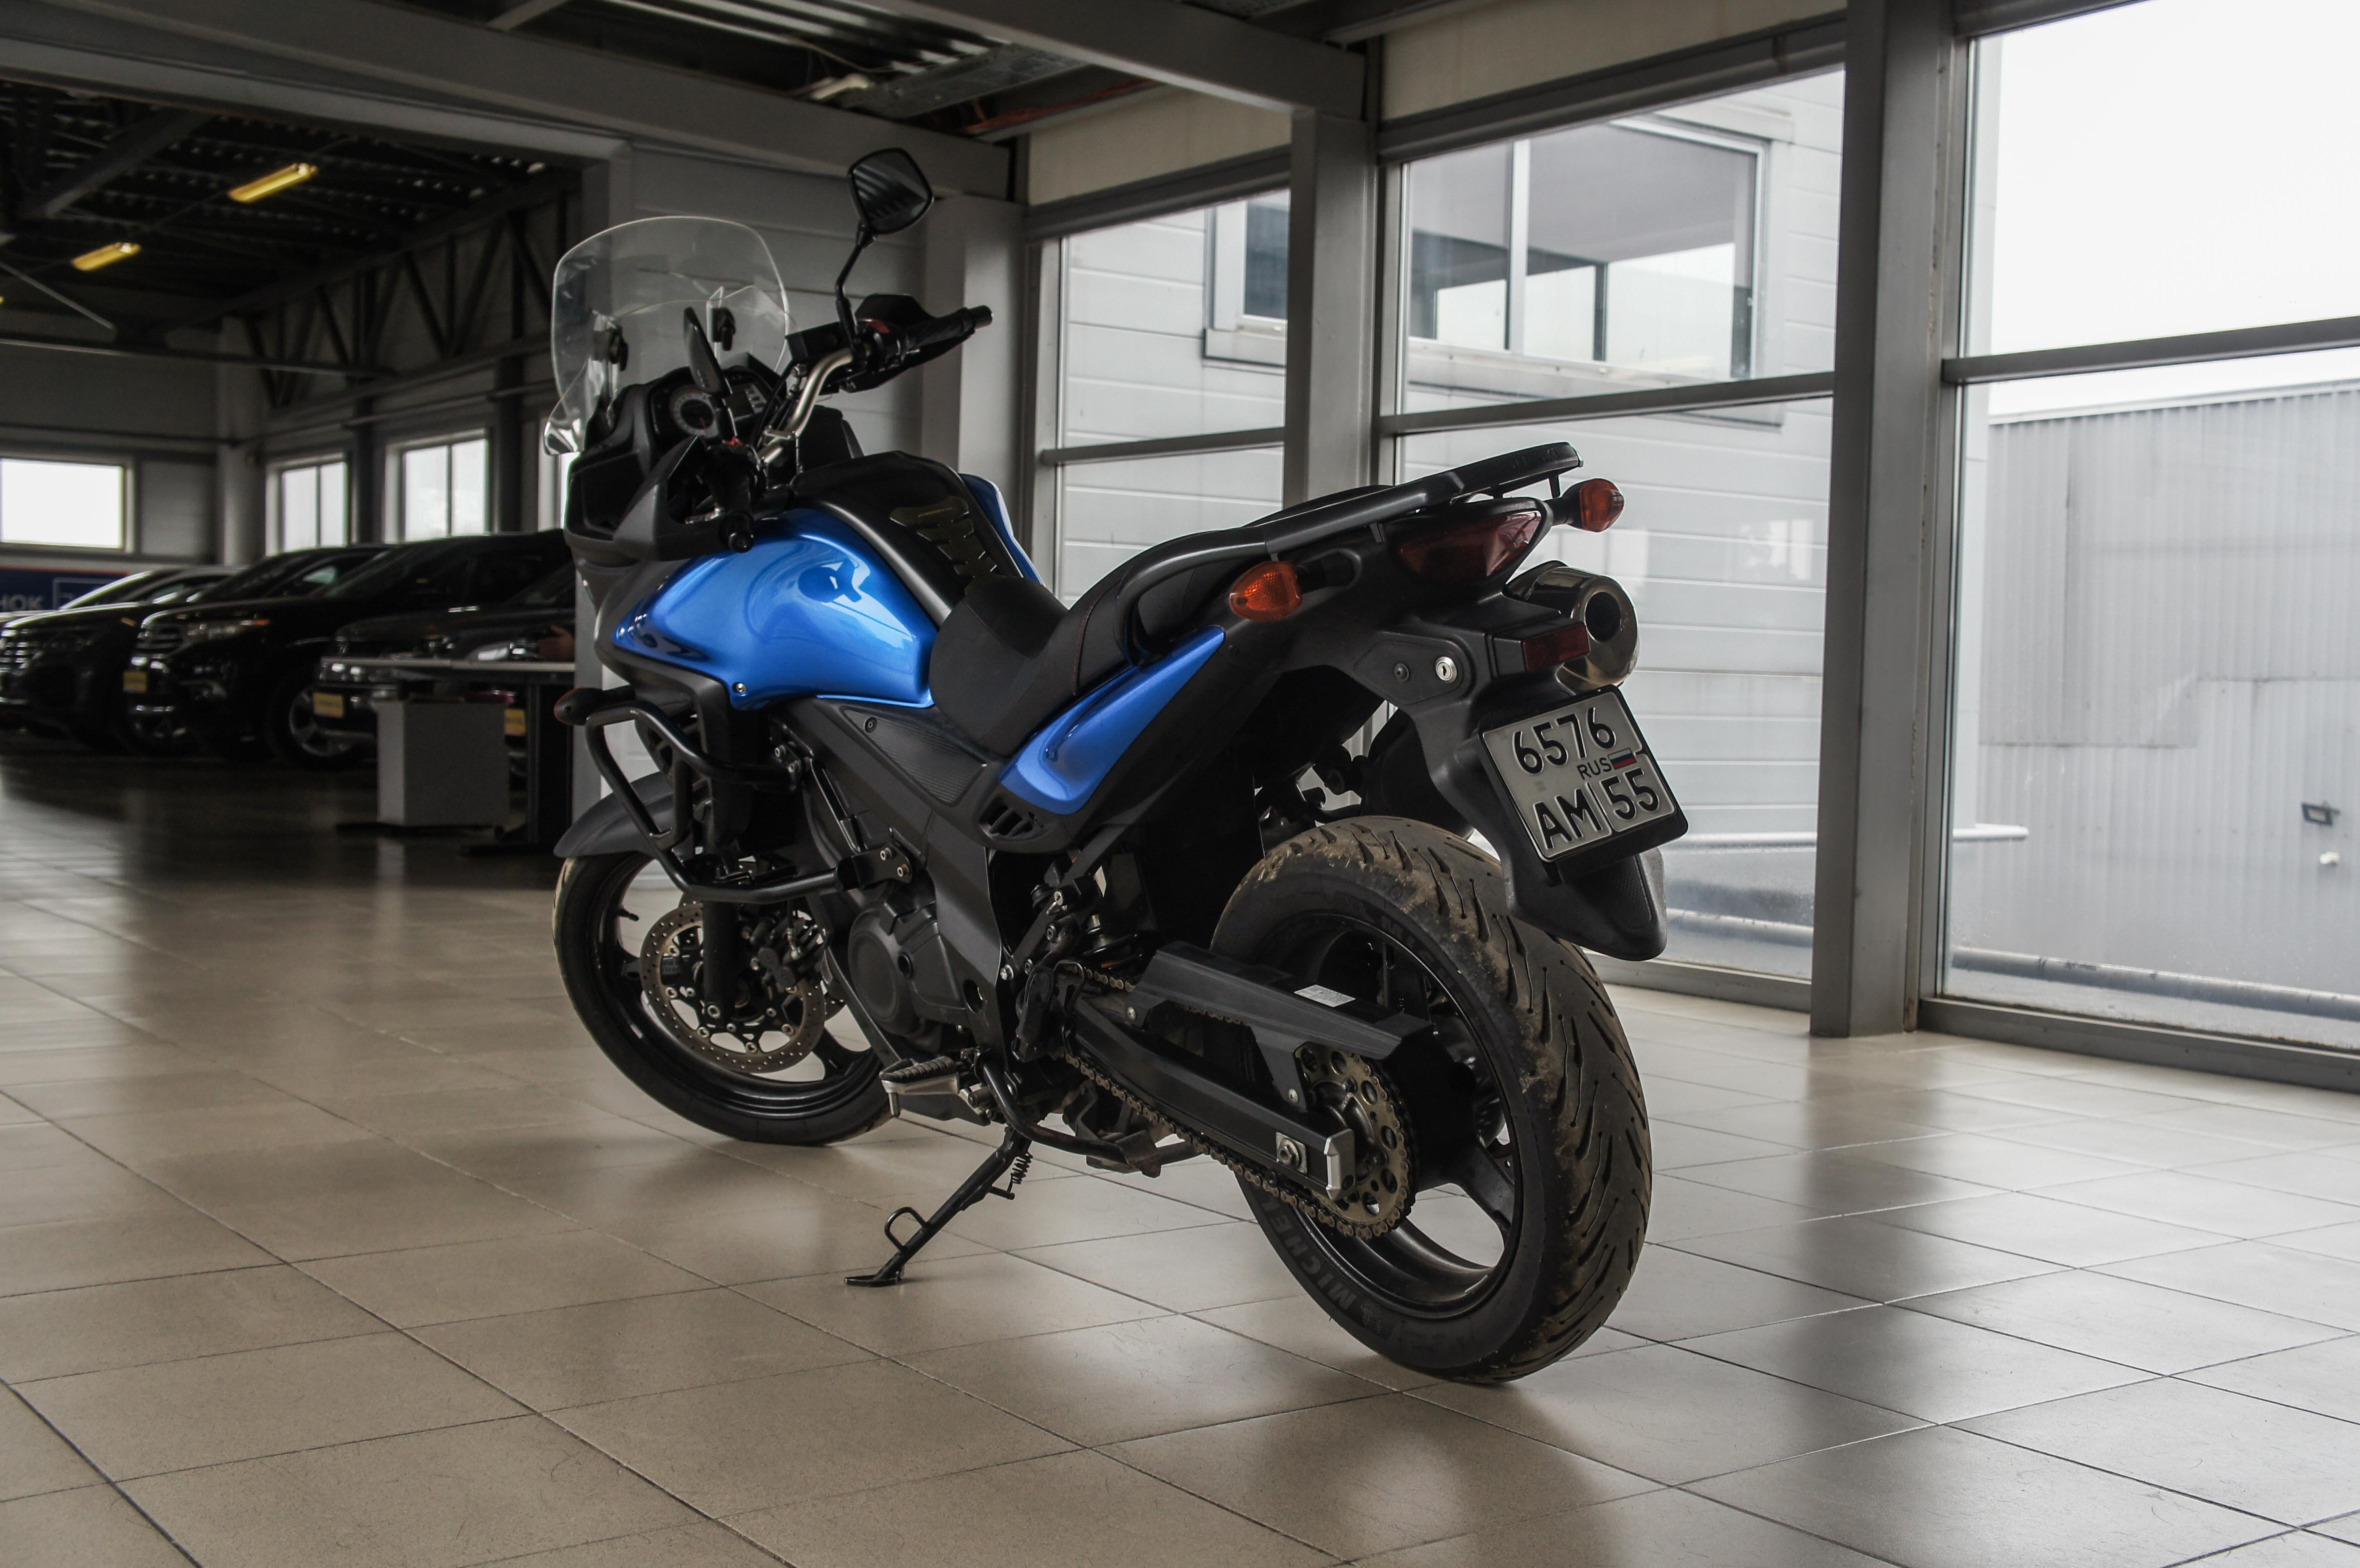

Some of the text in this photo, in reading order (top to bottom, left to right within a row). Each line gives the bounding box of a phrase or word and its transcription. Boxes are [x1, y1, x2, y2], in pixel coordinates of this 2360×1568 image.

[1512, 707, 1616, 775] 6576
[1576, 757, 1612, 780] RUS
[1534, 768, 1659, 849] AM 55
